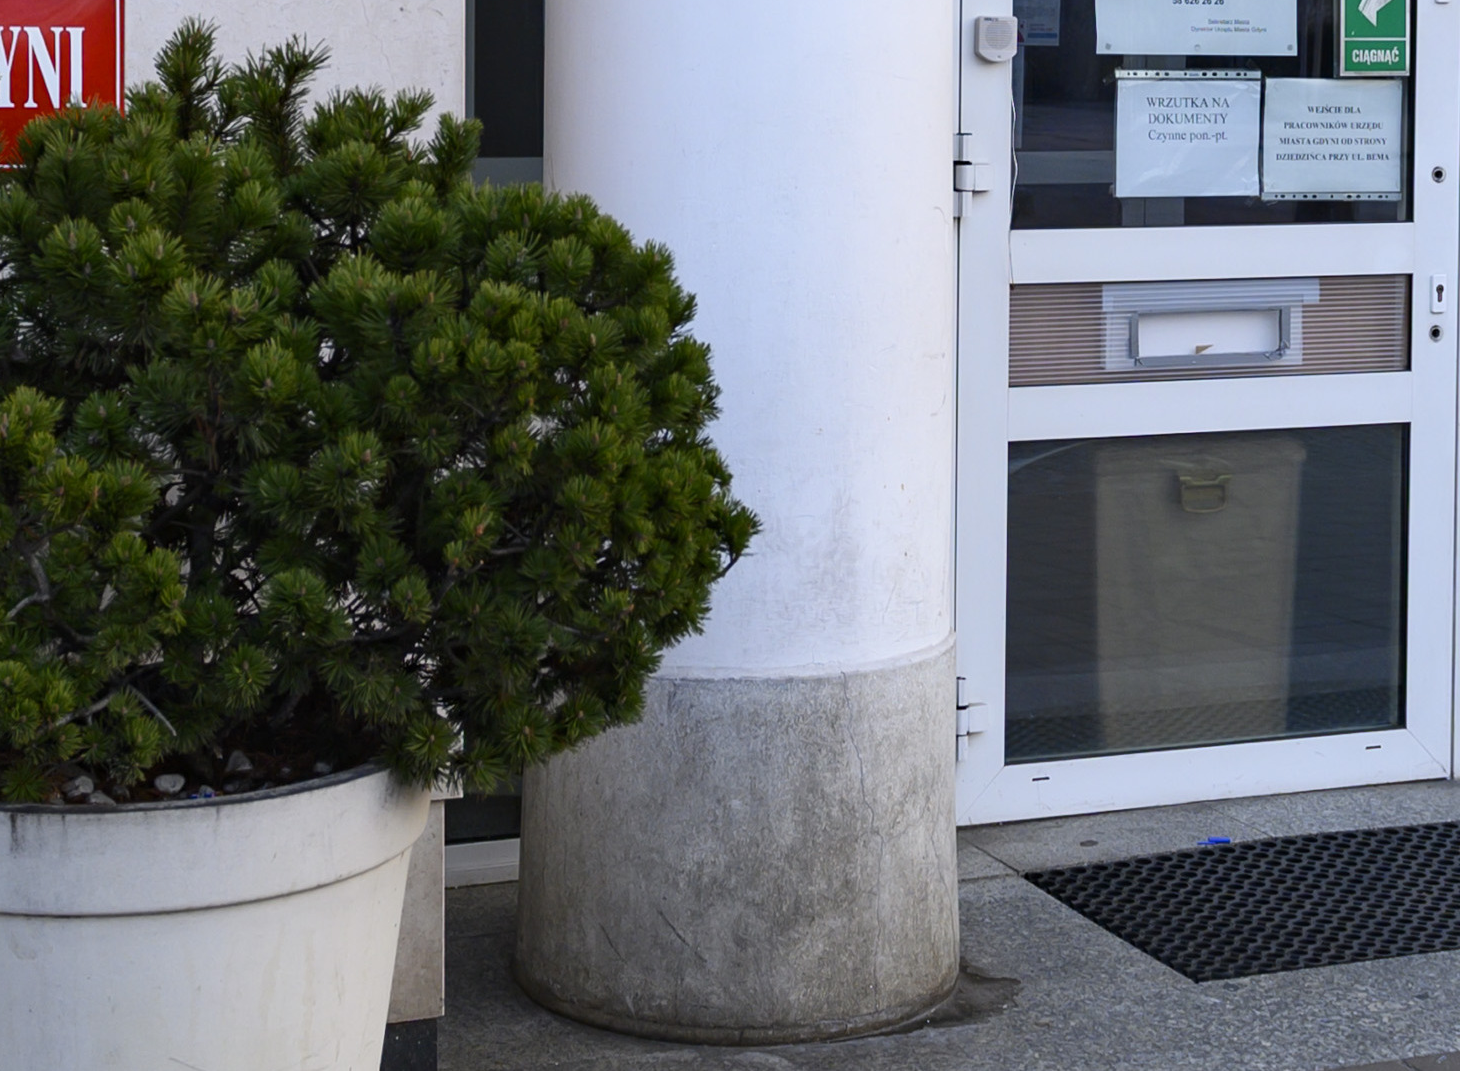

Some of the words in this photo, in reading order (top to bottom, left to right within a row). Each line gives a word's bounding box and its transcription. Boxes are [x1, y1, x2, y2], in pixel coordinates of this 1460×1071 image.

[1351, 46, 1400, 65] CIĄGNĄĆ
[1146, 96, 1209, 108] WRZUTKA
[1212, 97, 1230, 108] NA
[1307, 104, 1343, 114] WEJŚCIE
[1344, 106, 1361, 114] DLA
[1148, 112, 1229, 125] DOKUMENTY
[1284, 120, 1349, 130] PRACOWNIKÓW
[1148, 129, 1187, 143] Czynne
[1279, 137, 1311, 145] MIASTA
[1312, 137, 1340, 145] GDYNI
[1341, 137, 1353, 145] OD
[1354, 137, 1387, 145] STRONY
[1328, 153, 1349, 161] PRZY
[1366, 153, 1390, 161] BEMA
